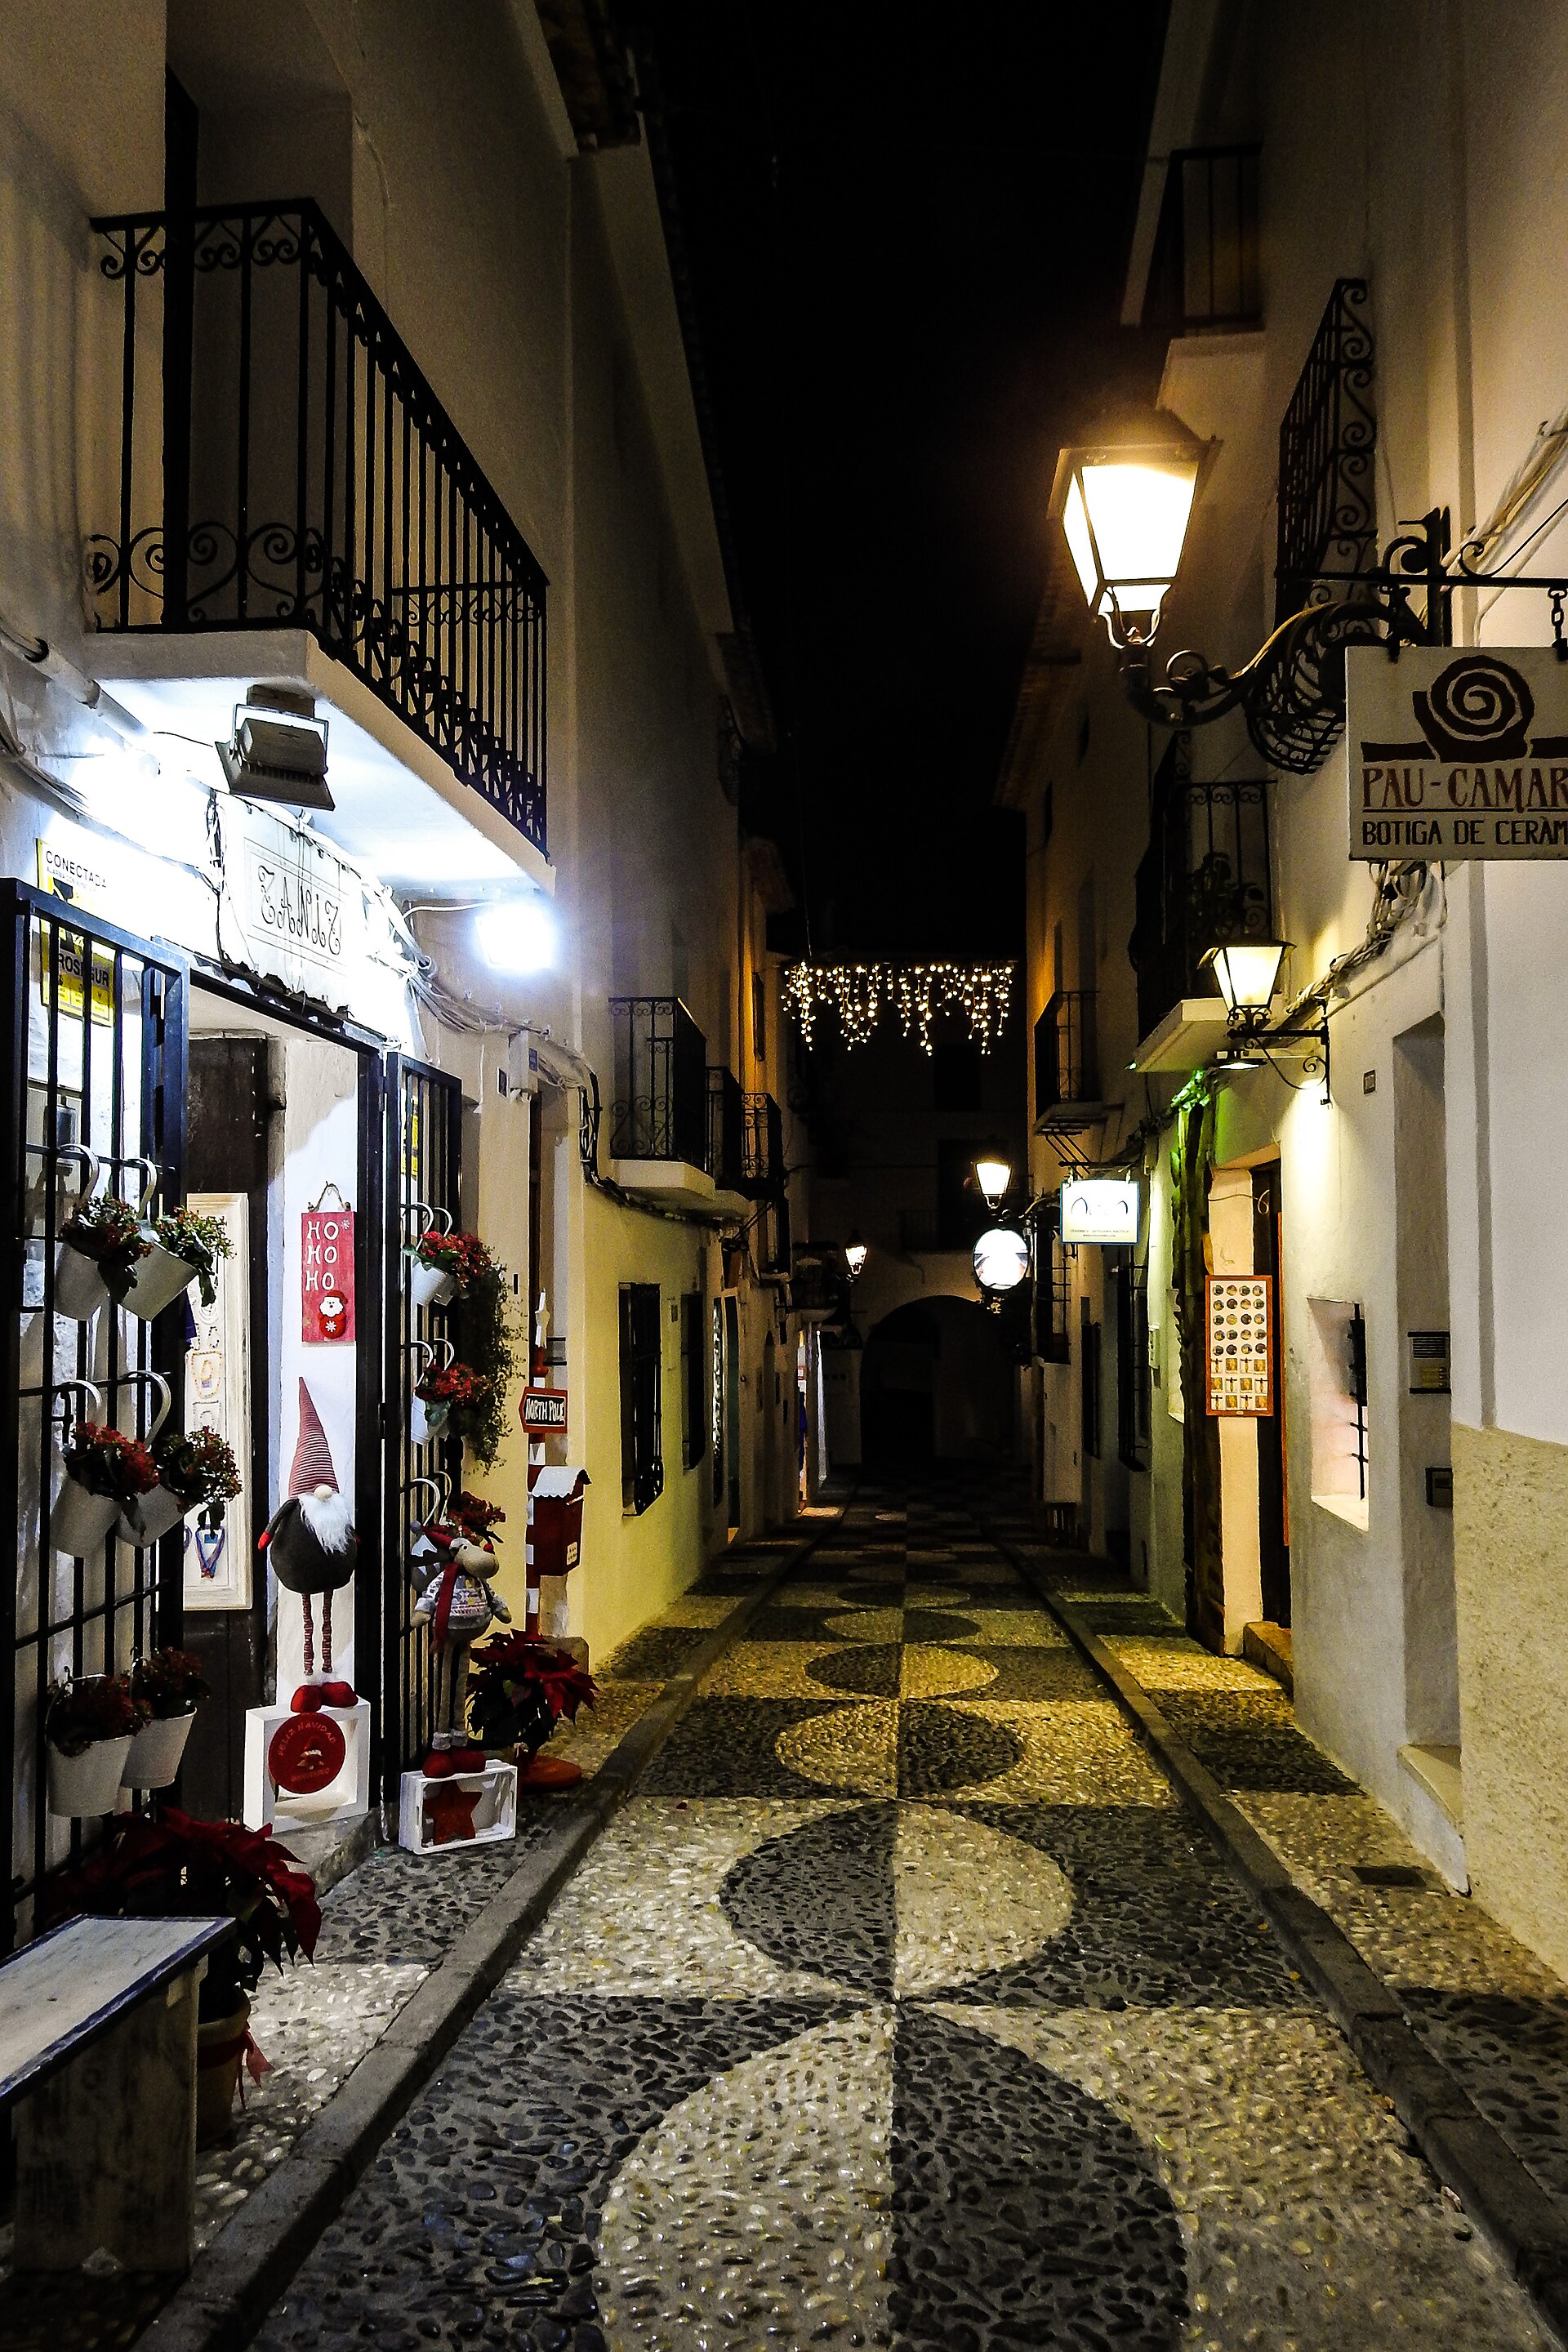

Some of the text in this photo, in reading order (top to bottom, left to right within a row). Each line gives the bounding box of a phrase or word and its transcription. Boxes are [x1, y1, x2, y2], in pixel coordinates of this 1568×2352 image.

[1362, 815, 1568, 845] BOTIGA DE CERÀM
[46, 850, 107, 889] CONECTADA
[306, 1220, 339, 1241] HO
[306, 1244, 338, 1265] HO
[305, 1269, 335, 1291] HO
[525, 1397, 565, 1422] NORTH POLE
